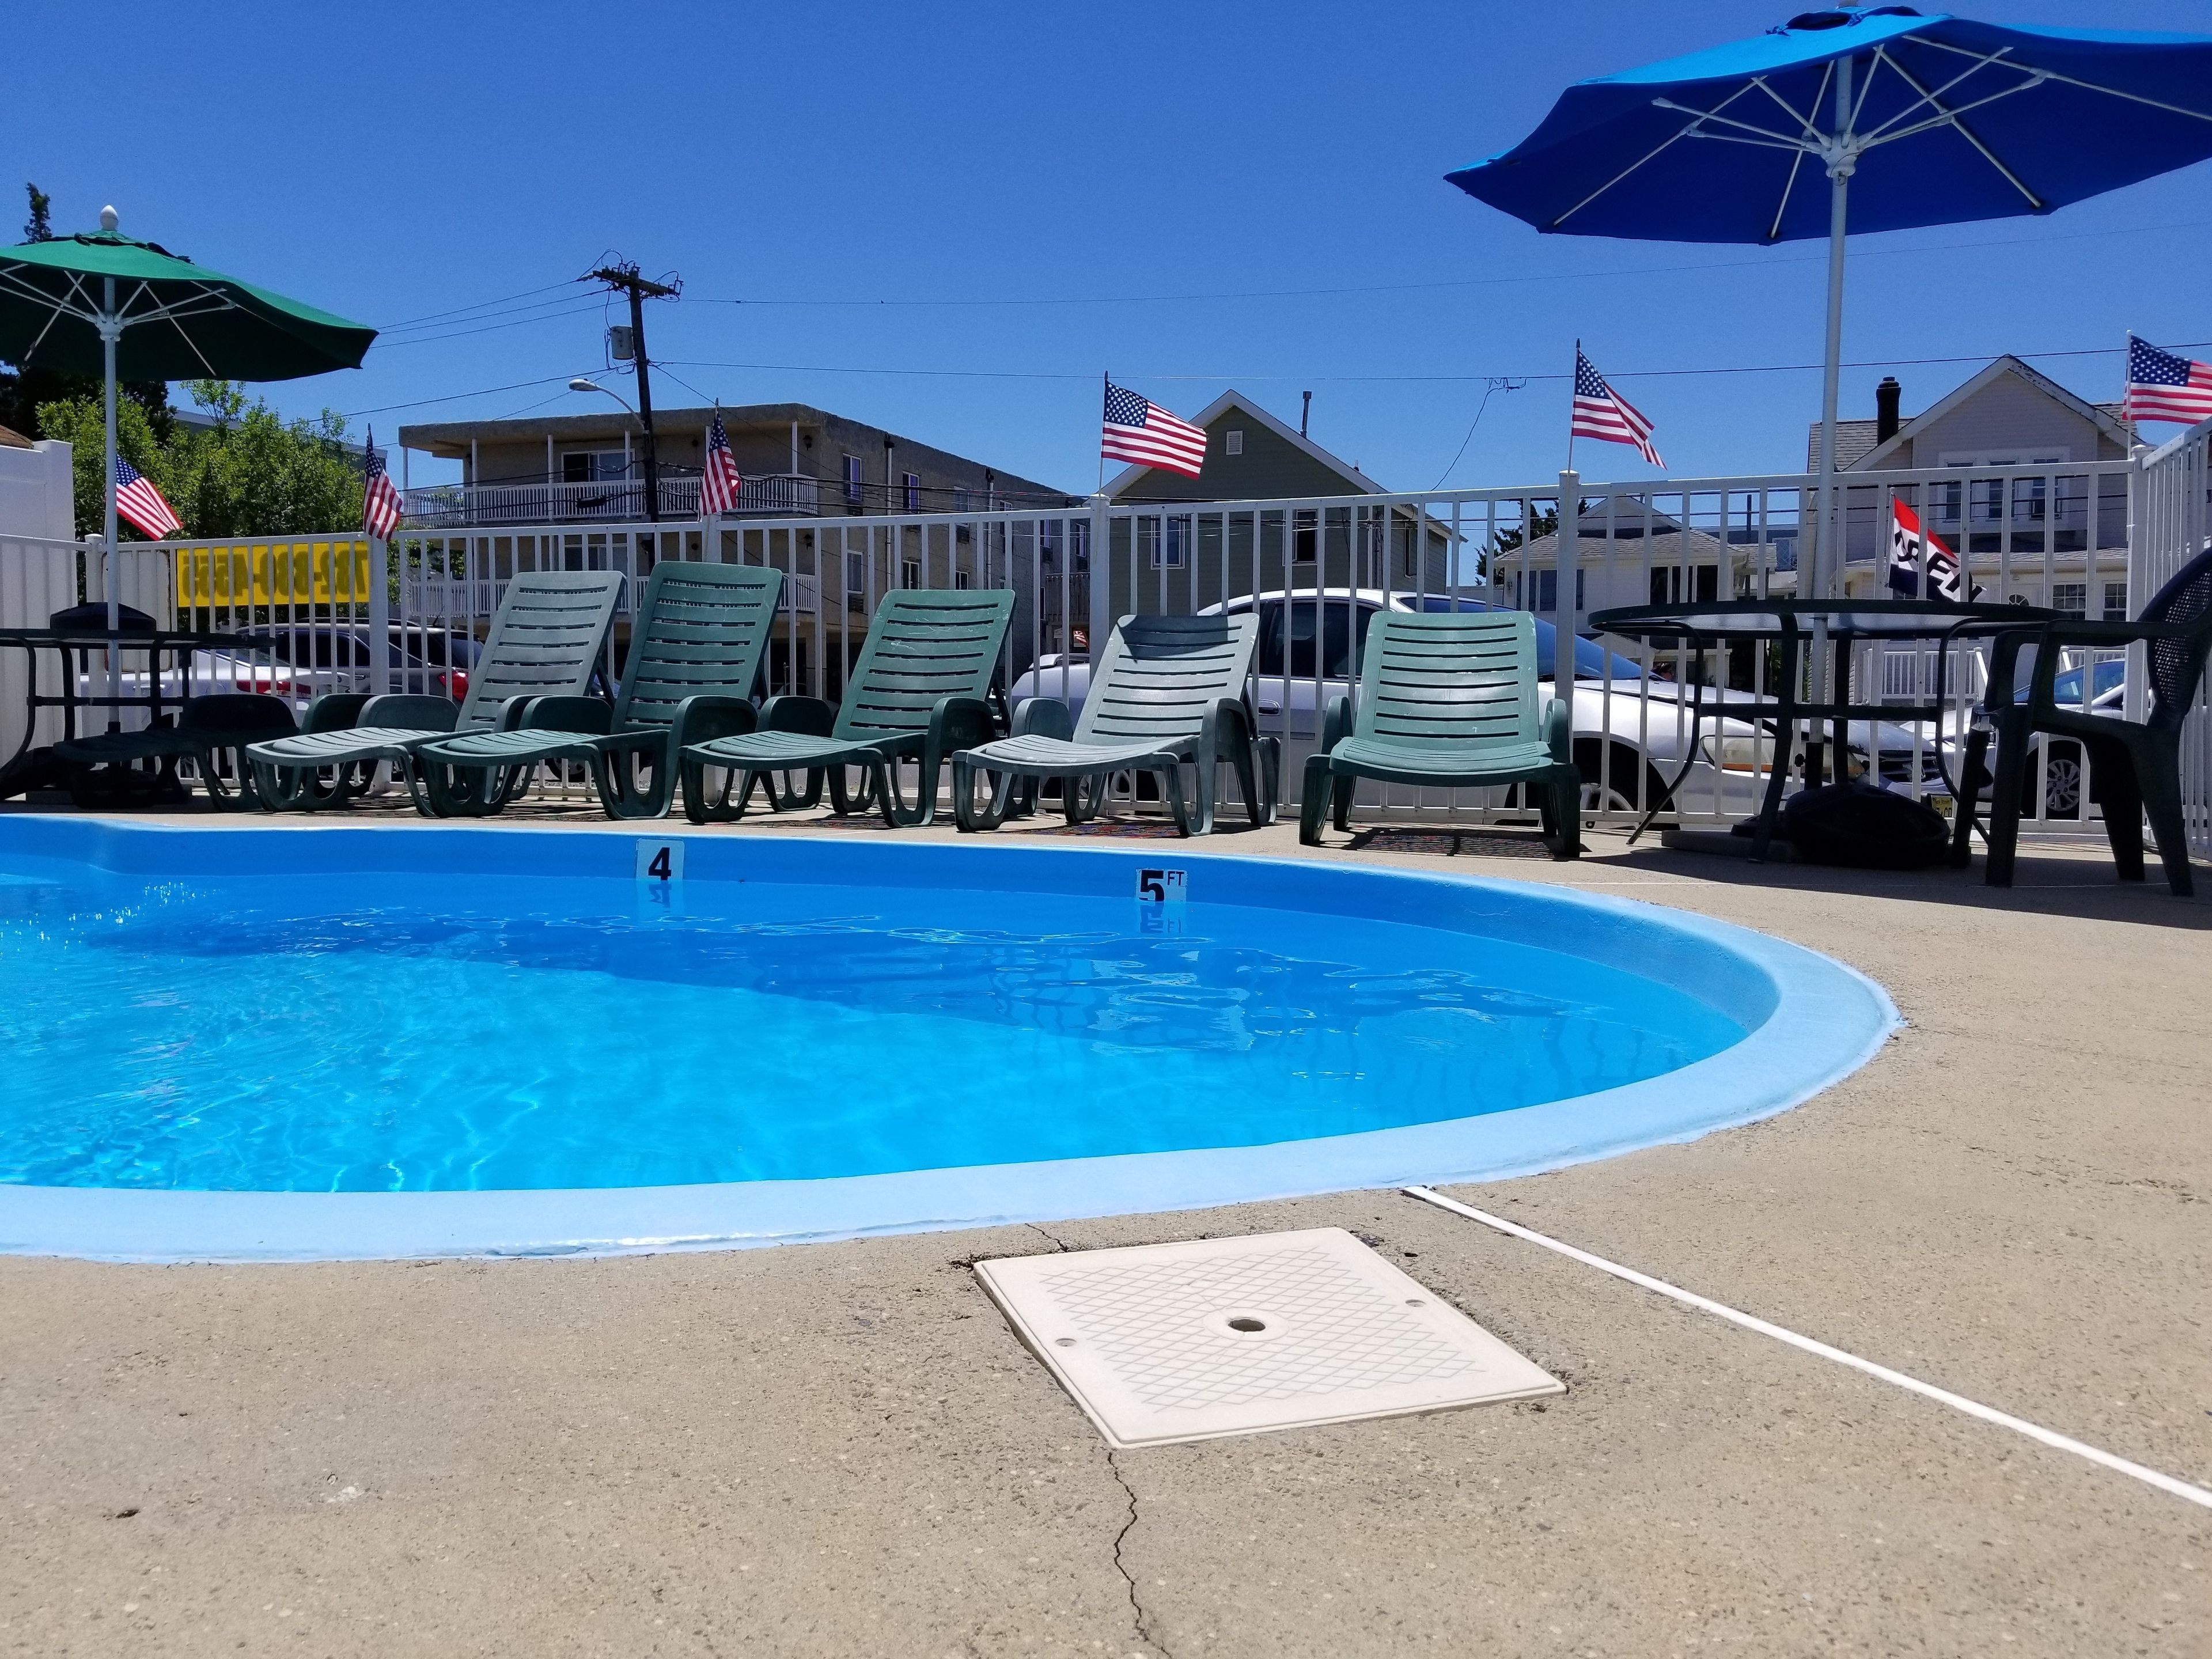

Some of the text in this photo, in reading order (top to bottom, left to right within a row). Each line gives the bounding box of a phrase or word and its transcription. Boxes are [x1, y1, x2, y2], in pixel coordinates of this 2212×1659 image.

[648, 847, 672, 880] 4
[1139, 870, 1184, 902] 5 FT
